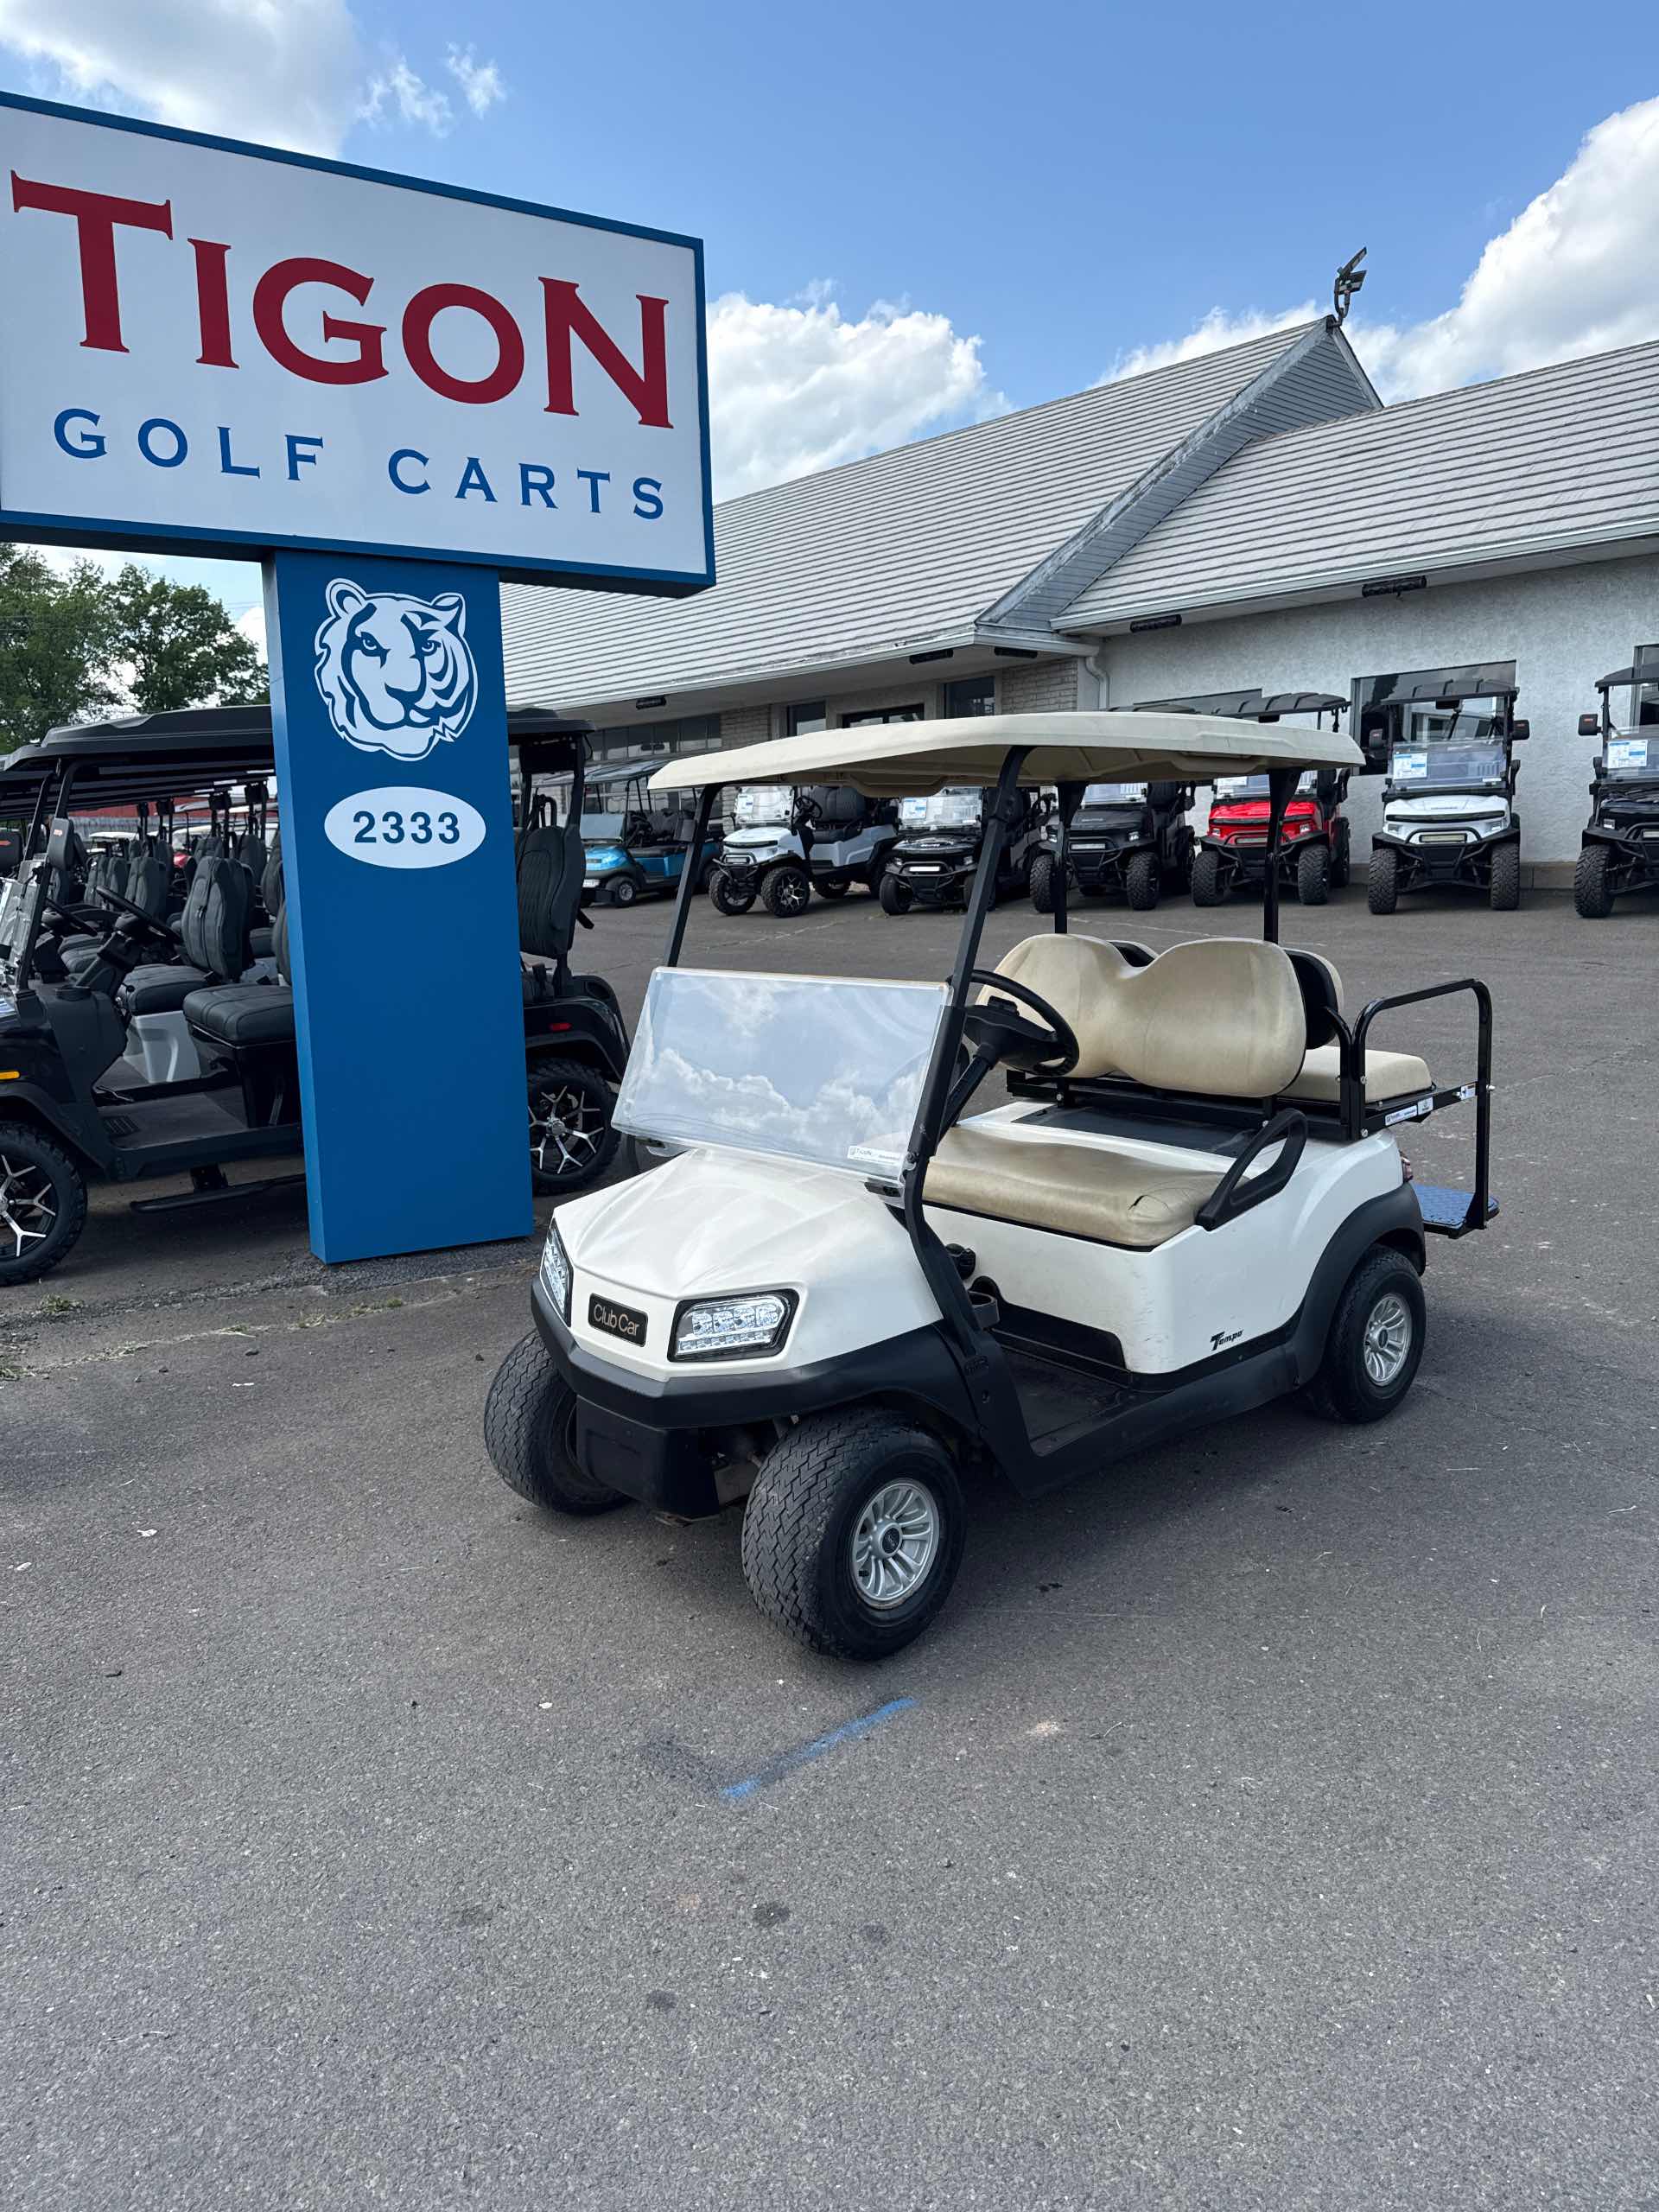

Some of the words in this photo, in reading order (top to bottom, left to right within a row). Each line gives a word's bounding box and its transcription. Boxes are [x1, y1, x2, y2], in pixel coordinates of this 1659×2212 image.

[11, 170, 673, 429] TIGON
[54, 409, 323, 480] GOLF
[389, 449, 663, 519] CARTS
[353, 810, 461, 844] 2333
[594, 1303, 617, 1328] Club
[618, 1313, 639, 1337] Car
[1210, 1329, 1244, 1351] Tempo
